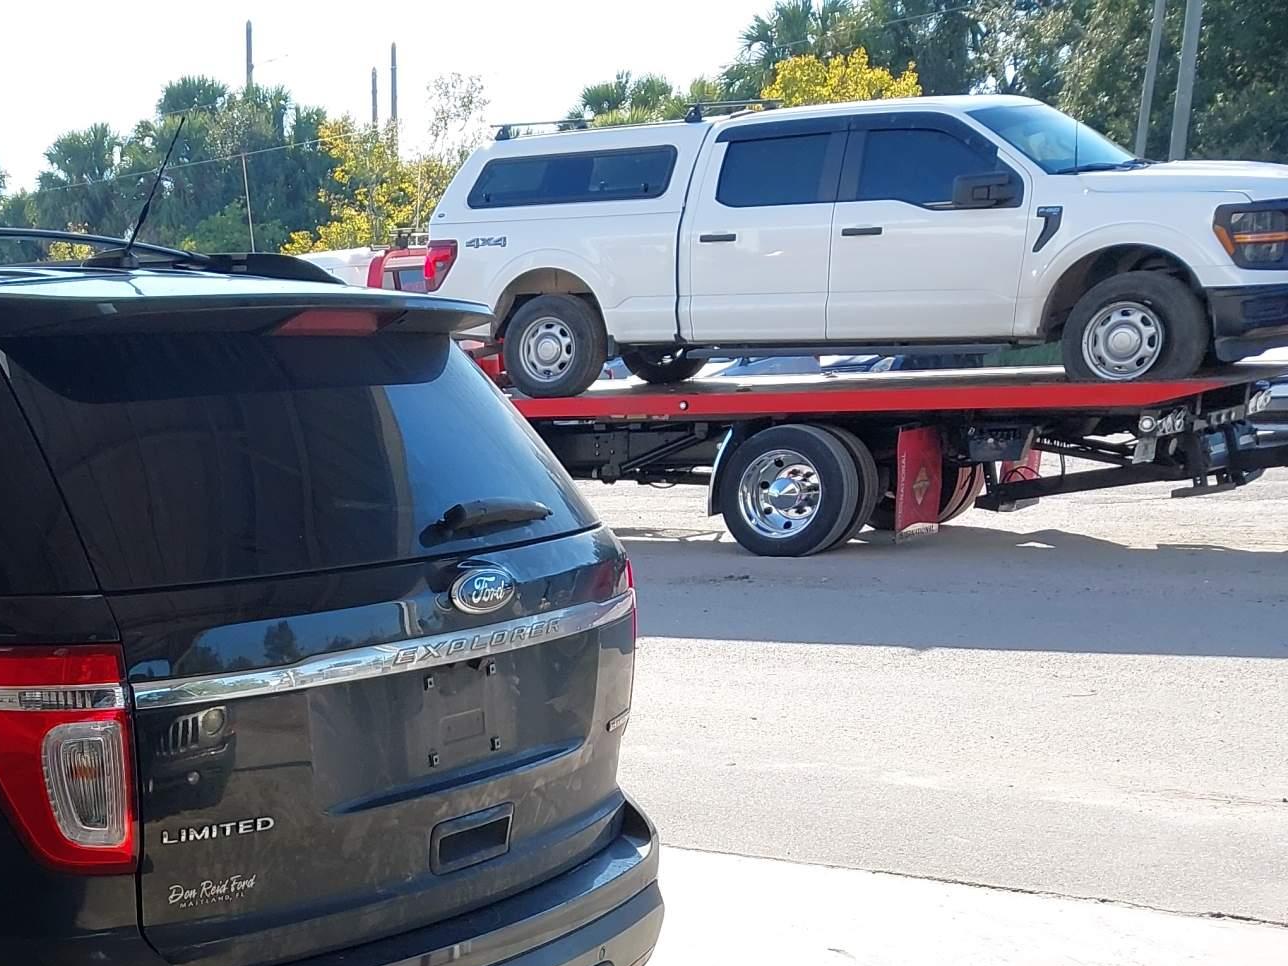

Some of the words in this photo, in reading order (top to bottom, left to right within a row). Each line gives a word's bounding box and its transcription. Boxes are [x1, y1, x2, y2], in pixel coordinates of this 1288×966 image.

[471, 576, 506, 604] Ford
[392, 617, 562, 666] EXPLORER
[162, 817, 274, 844] LIMITED
[168, 884, 197, 904] Don
[199, 880, 229, 898] Reid
[230, 874, 256, 892] Ford
